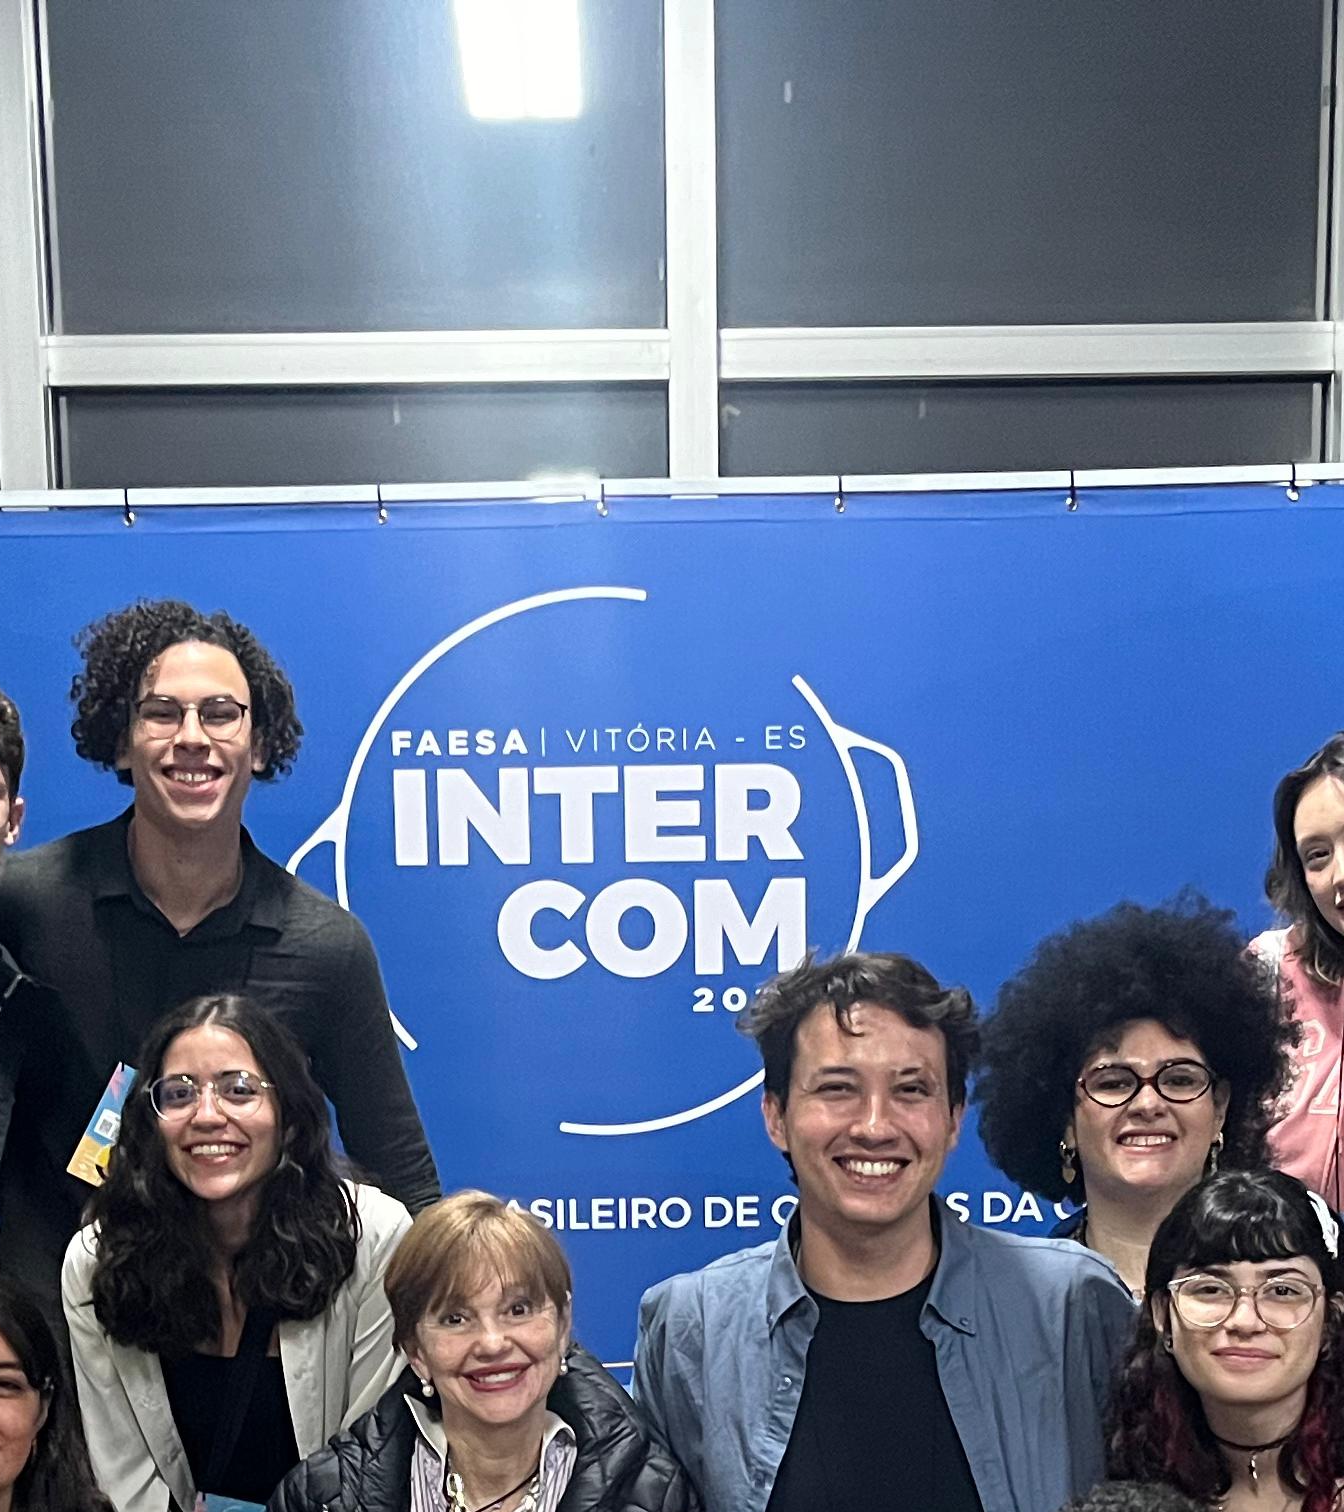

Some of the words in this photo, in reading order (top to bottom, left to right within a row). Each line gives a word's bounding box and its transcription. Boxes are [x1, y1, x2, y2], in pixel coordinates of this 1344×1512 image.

[391, 729, 529, 757] FAESA
[565, 723, 717, 753] VITÓRIA
[765, 725, 807, 750] ES
[392, 762, 805, 867] INTER
[497, 877, 807, 979] COM
[506, 1197, 692, 1230] SILEIRO
[703, 1195, 761, 1228] DE
[983, 1191, 1044, 1223] DA
